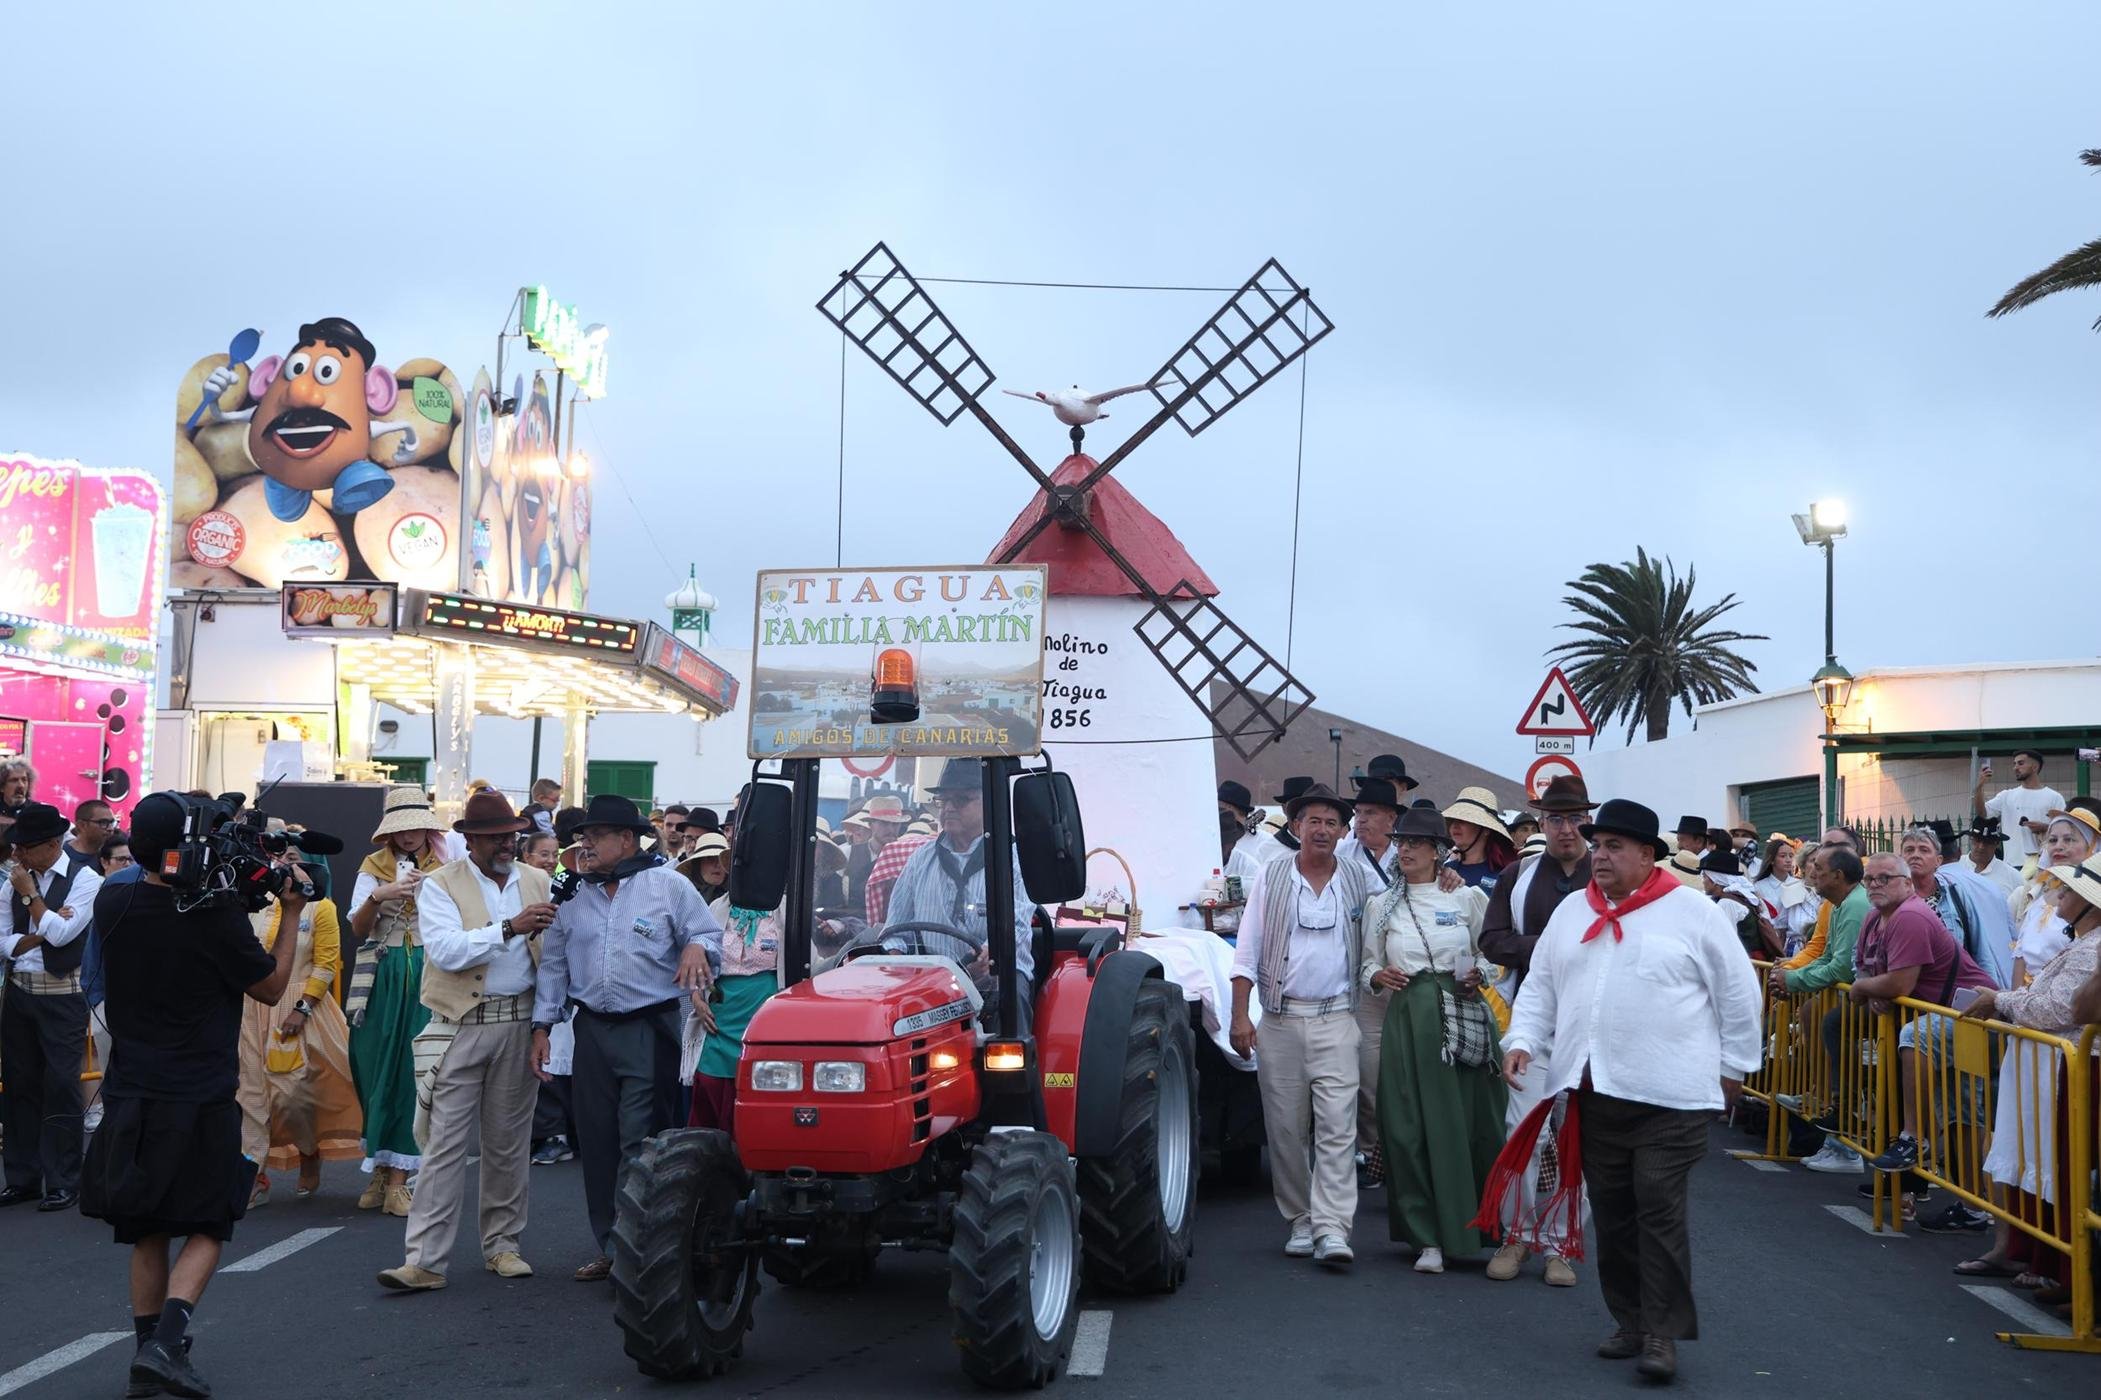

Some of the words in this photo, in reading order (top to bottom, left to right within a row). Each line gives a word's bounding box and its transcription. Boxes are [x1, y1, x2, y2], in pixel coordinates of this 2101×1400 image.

[192, 527, 242, 552] ORGANIC
[788, 574, 1013, 604] TIAGUA
[293, 590, 378, 625] Marbelys
[762, 615, 895, 646] FAMILIA
[901, 607, 1034, 644] MARTÍN
[1058, 656, 1079, 671] de
[1042, 678, 1108, 704] Tiagua
[773, 728, 853, 746] AMIGOS
[863, 728, 890, 745] DE
[901, 727, 1010, 745] CANARIAS
[1539, 741, 1559, 749] 400
[907, 1016, 923, 1029] 1335
